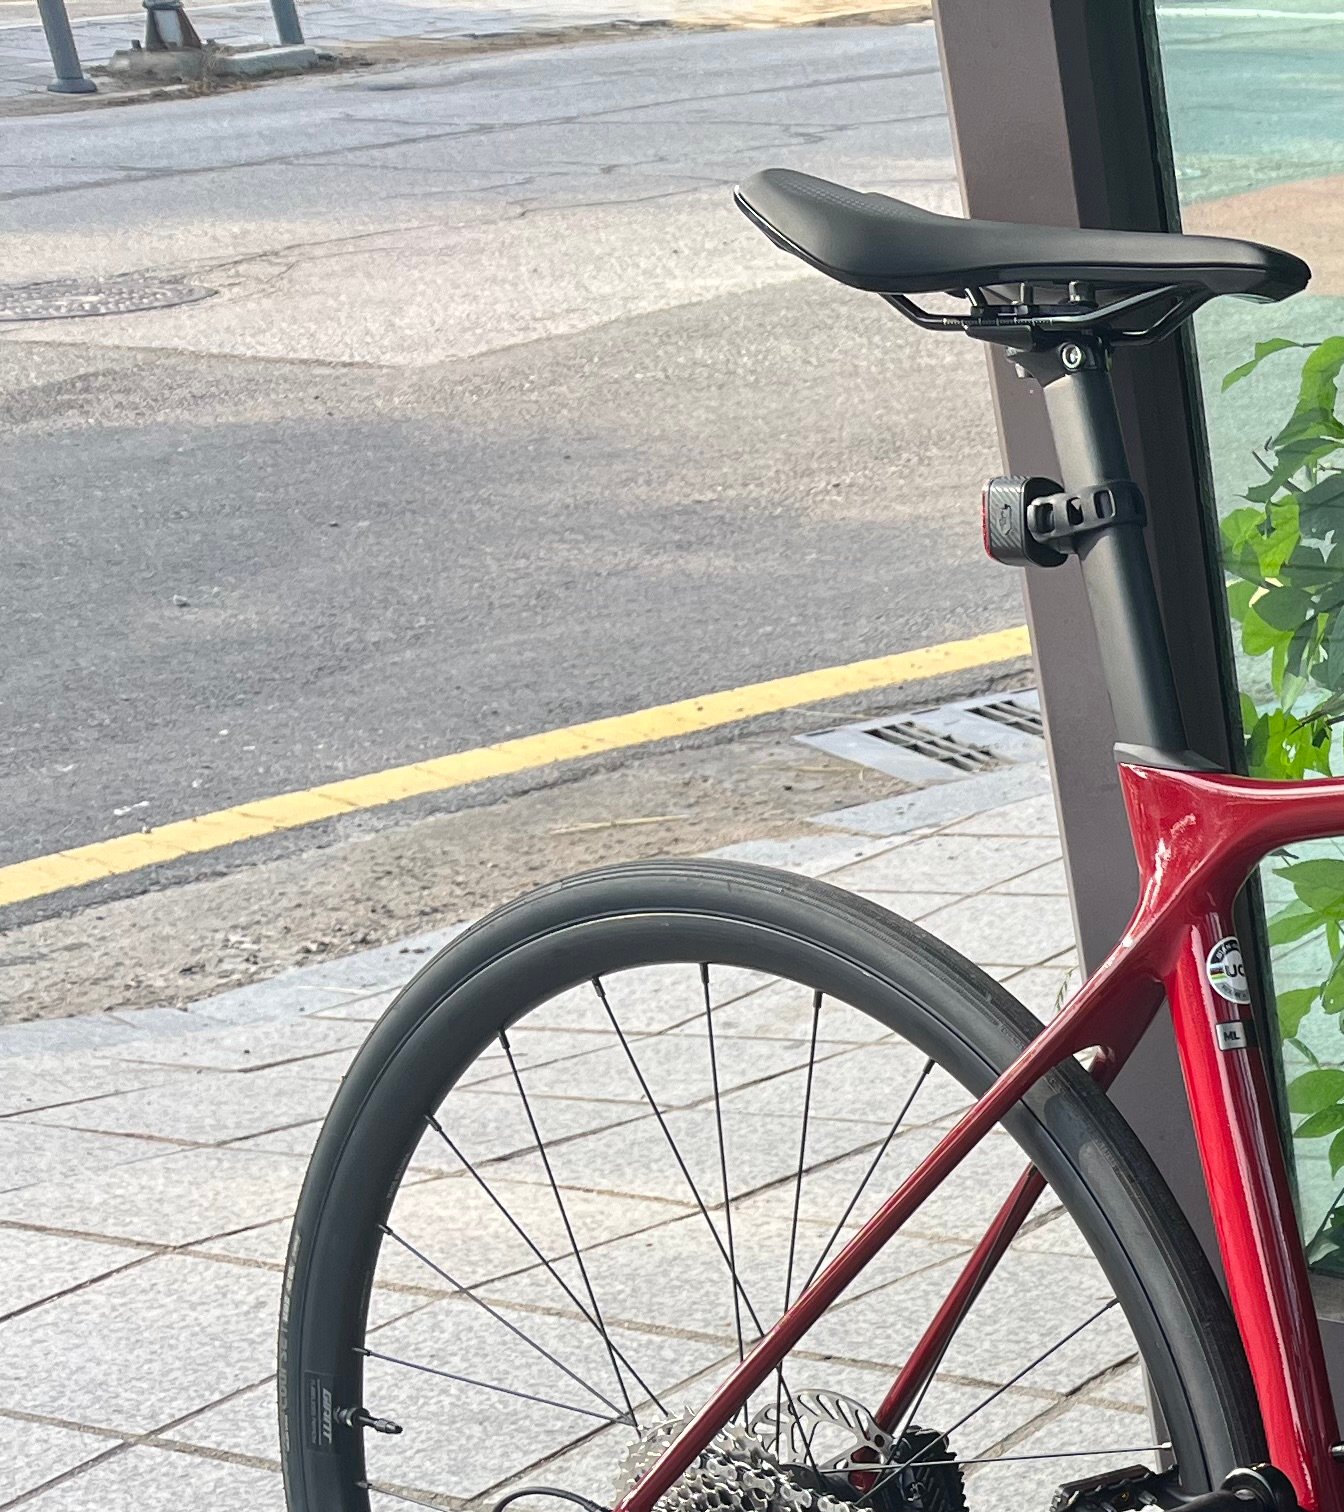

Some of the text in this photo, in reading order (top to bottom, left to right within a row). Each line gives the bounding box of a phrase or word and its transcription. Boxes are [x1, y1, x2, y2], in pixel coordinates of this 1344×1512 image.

[1224, 963, 1245, 978] UC
[1223, 1030, 1241, 1042] ML
[321, 1387, 333, 1445] GIANT
